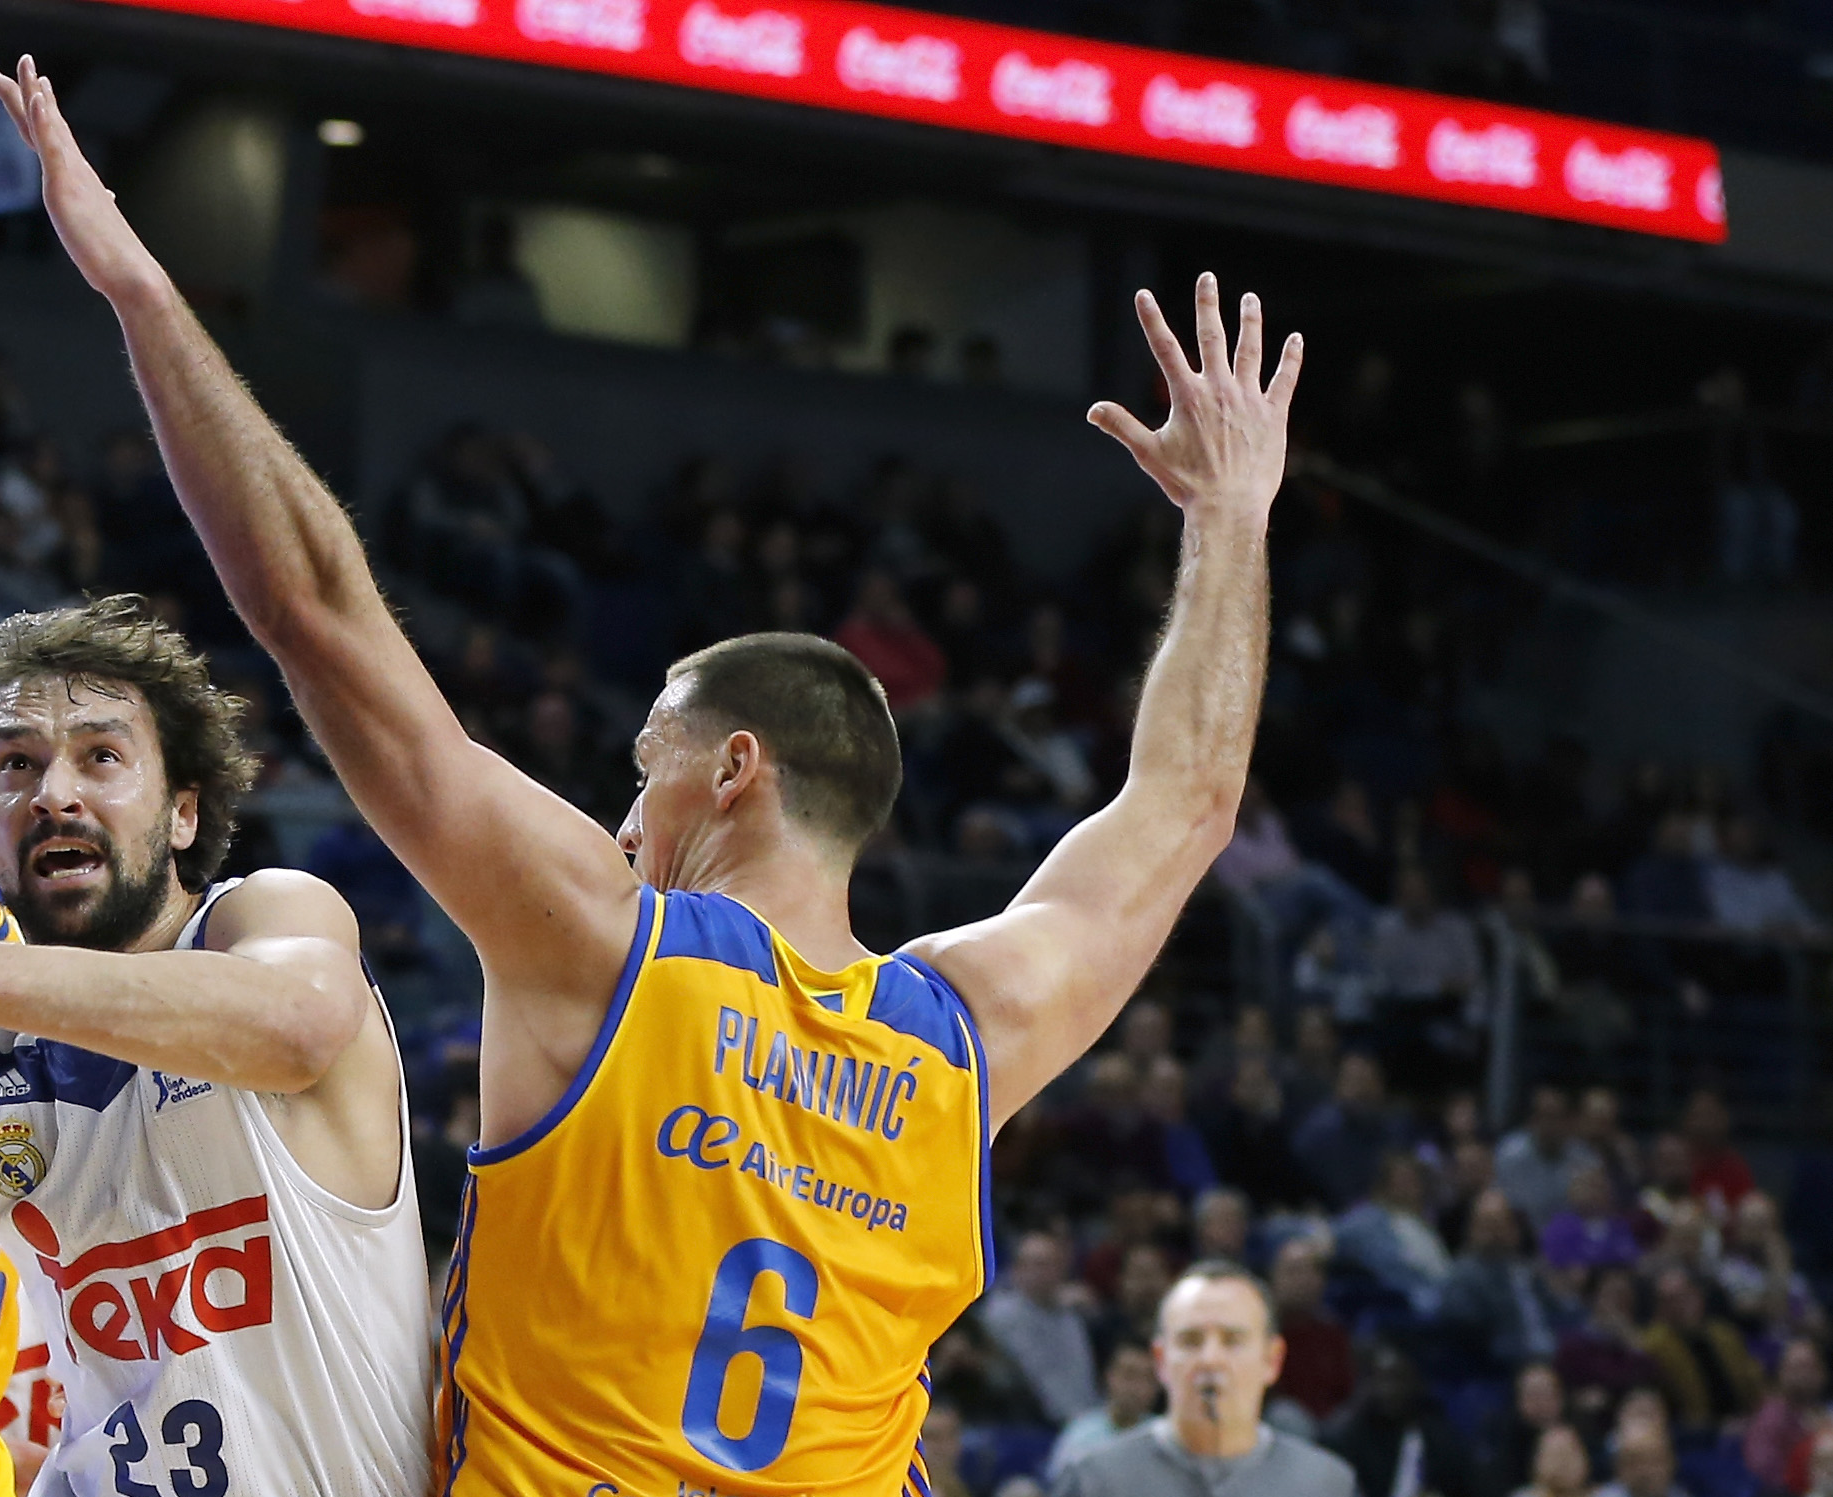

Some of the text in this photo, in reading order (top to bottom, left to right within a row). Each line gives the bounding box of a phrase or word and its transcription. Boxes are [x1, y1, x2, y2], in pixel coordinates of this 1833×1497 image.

[170, 1081, 212, 1103] endesa
[713, 1005, 919, 1141] PLANINIĆ
[680, 1237, 820, 1473] 6
